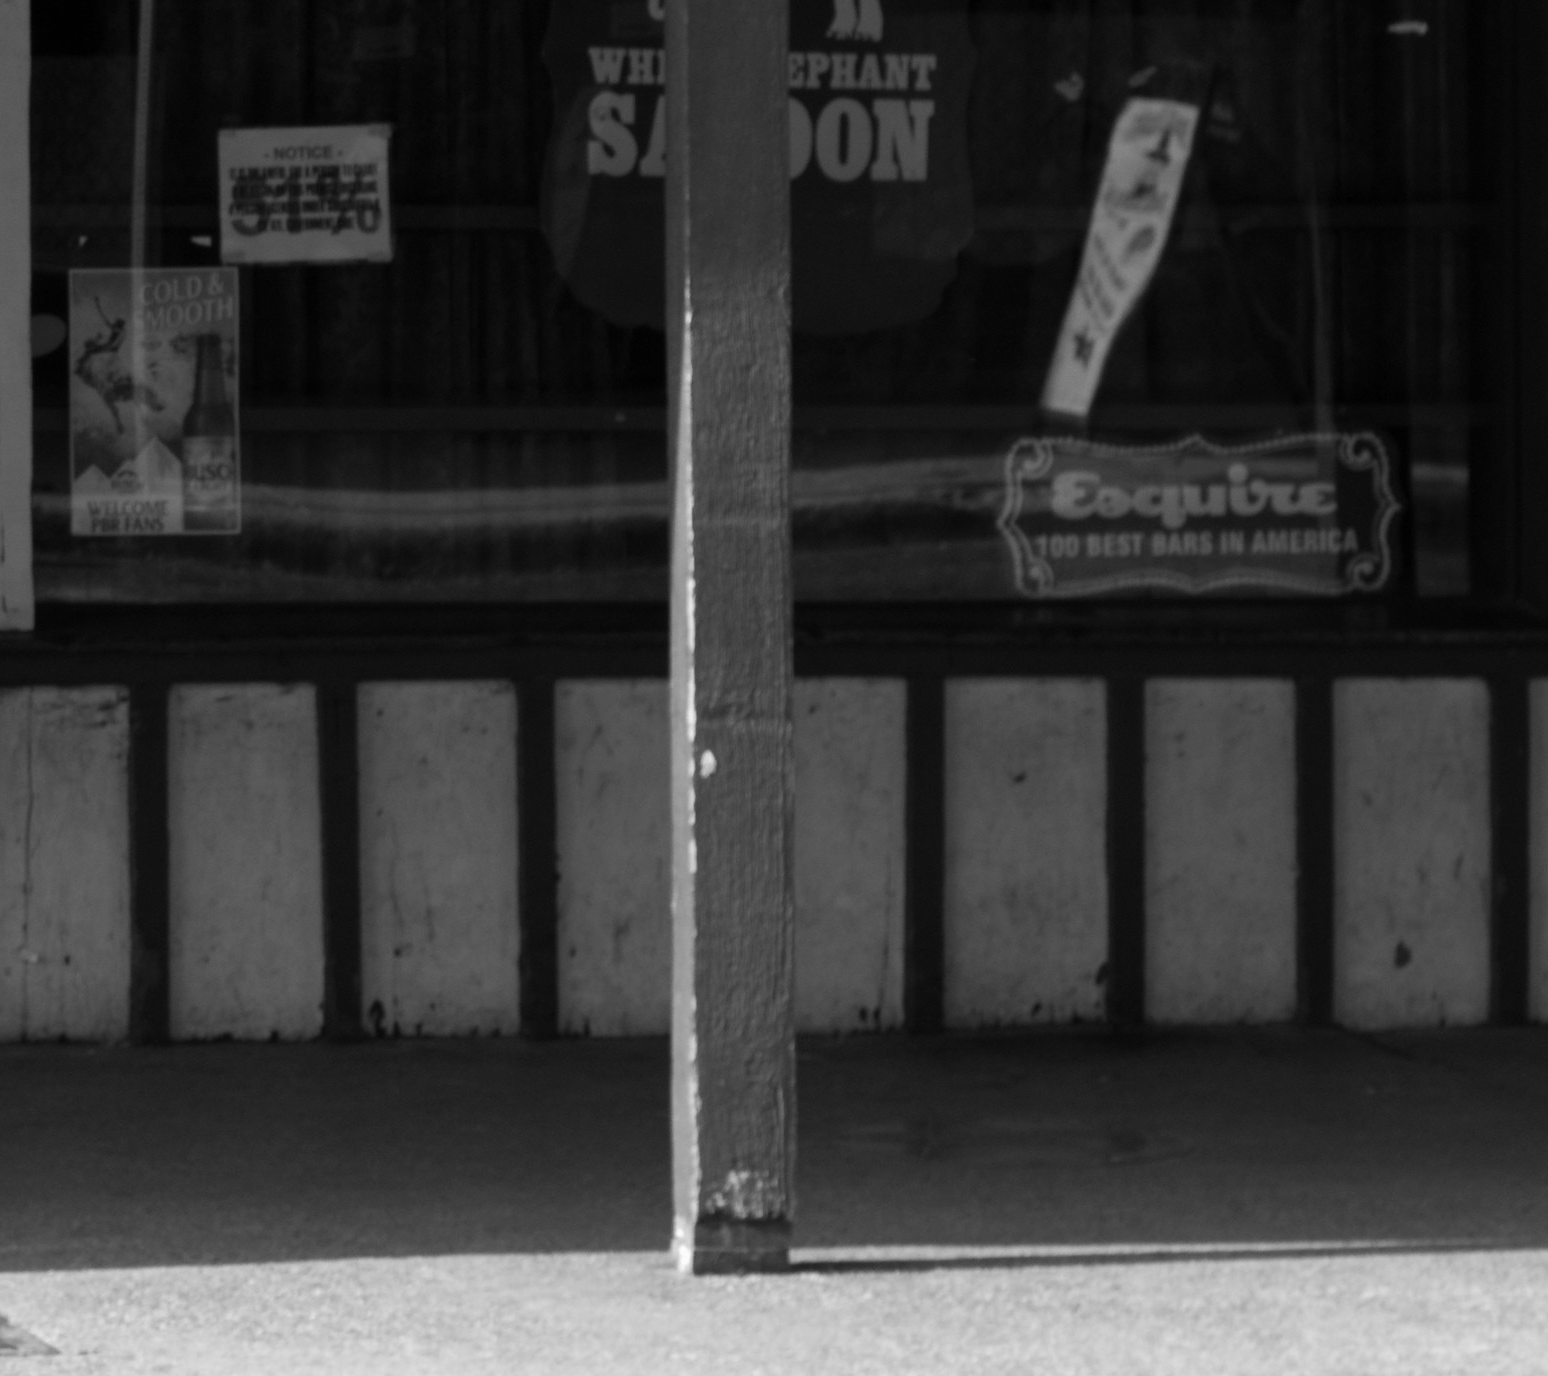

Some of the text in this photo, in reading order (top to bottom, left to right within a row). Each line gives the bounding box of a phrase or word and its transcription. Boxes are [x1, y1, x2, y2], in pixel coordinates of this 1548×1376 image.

[788, 52, 937, 90] EPHANT
[273, 145, 332, 160] NOTICE
[141, 275, 202, 306] COLD
[1051, 463, 1338, 529] Esquire
[1038, 529, 1357, 559] 100 BEST BARS IN AMERICA
